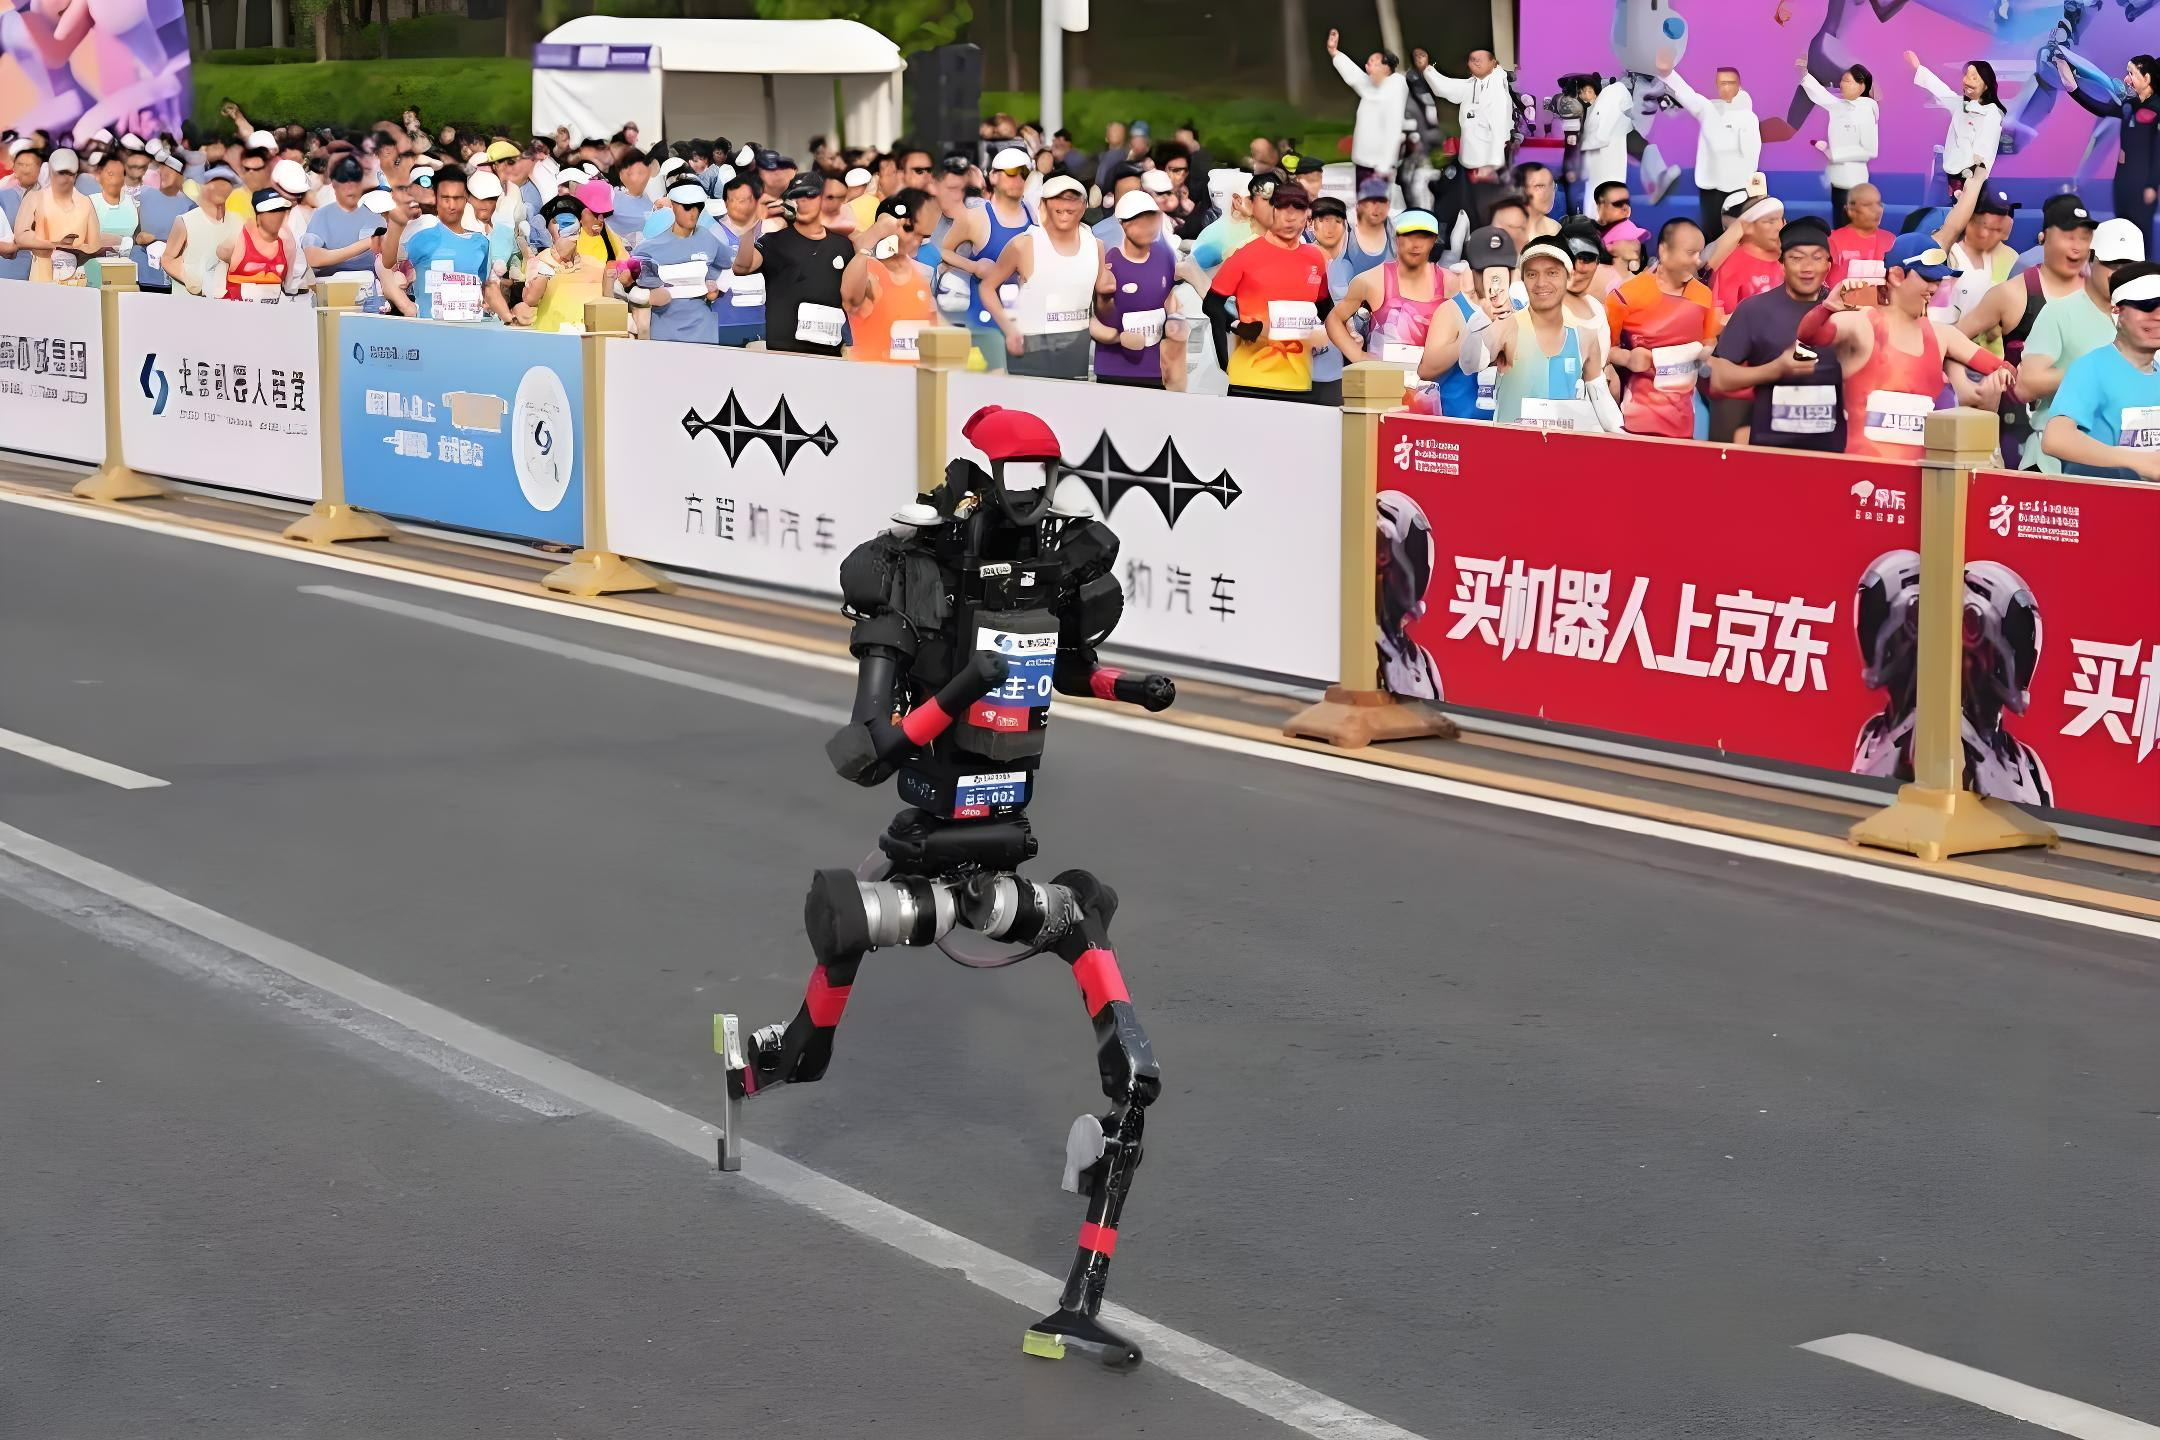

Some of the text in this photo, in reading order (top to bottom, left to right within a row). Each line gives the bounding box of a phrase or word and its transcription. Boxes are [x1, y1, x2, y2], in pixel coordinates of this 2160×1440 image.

[1446, 555, 1837, 692] 买机器人上京东
